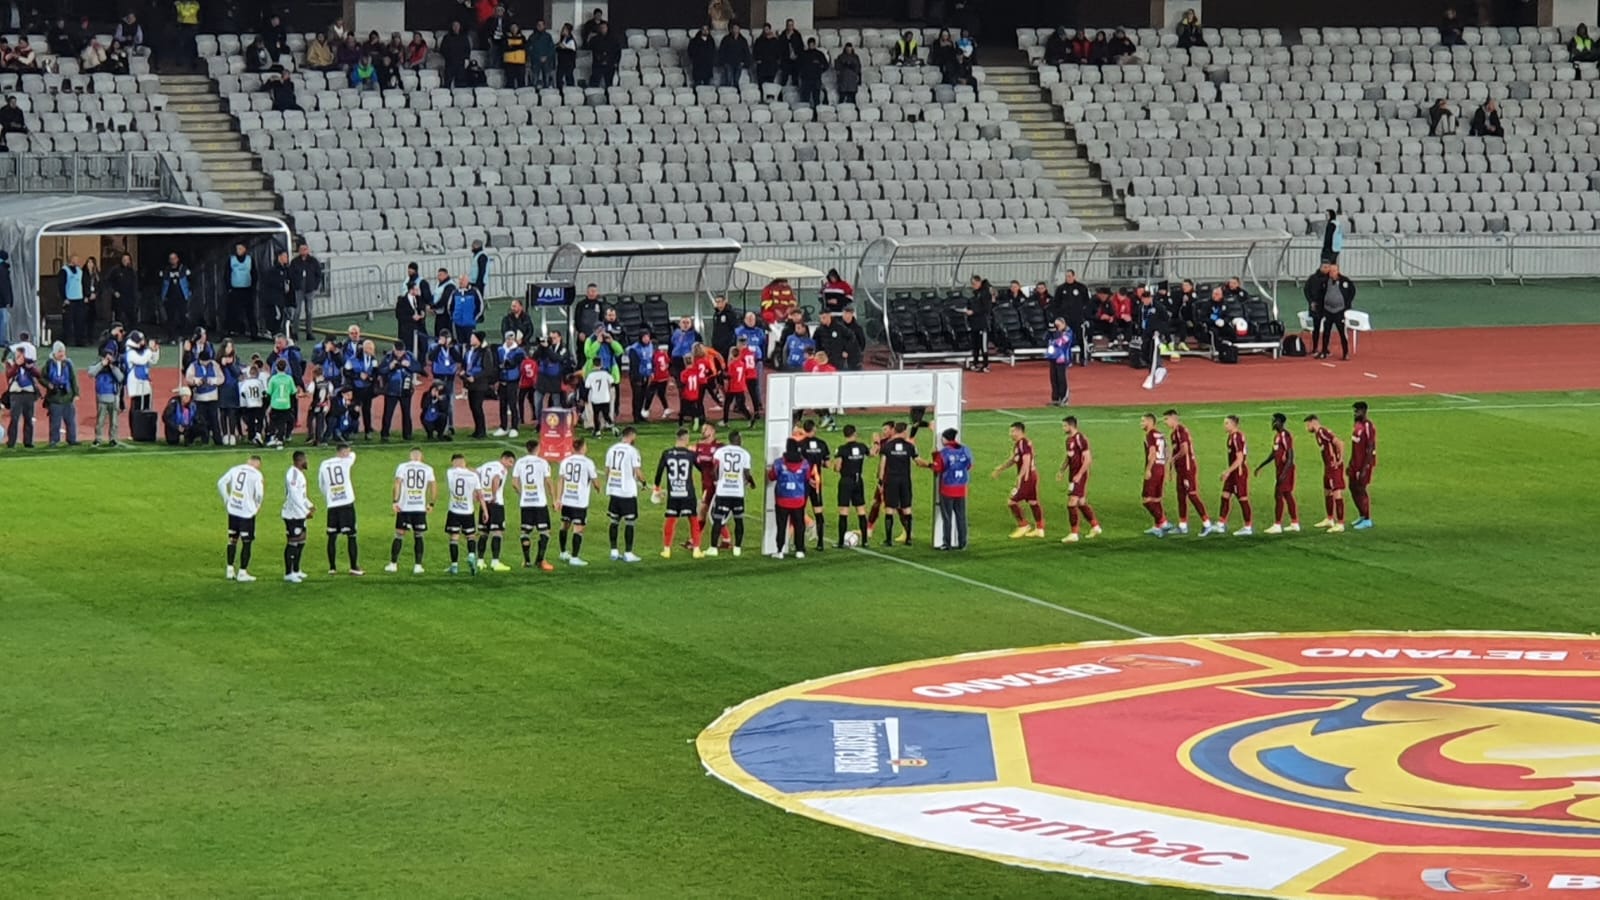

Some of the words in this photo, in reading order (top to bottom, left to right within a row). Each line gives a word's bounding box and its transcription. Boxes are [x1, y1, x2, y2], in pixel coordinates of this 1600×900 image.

[698, 363, 706, 378] 2
[736, 366, 744, 381] 7
[248, 385, 260, 399] 18
[596, 379, 602, 391] 7
[688, 374, 697, 391] 11
[612, 450, 625, 471] 17
[667, 458, 689, 480] 33
[723, 452, 741, 473] 52
[235, 471, 247, 491] 9
[326, 465, 345, 486] 18
[406, 468, 425, 489] 80
[483, 467, 492, 487] 5
[525, 464, 534, 485] 2
[565, 462, 582, 483] 98
[455, 478, 465, 497] 8
[1301, 647, 1568, 661] BETANO
[912, 662, 1122, 698] BETANO
[922, 802, 1249, 865] Pambac
